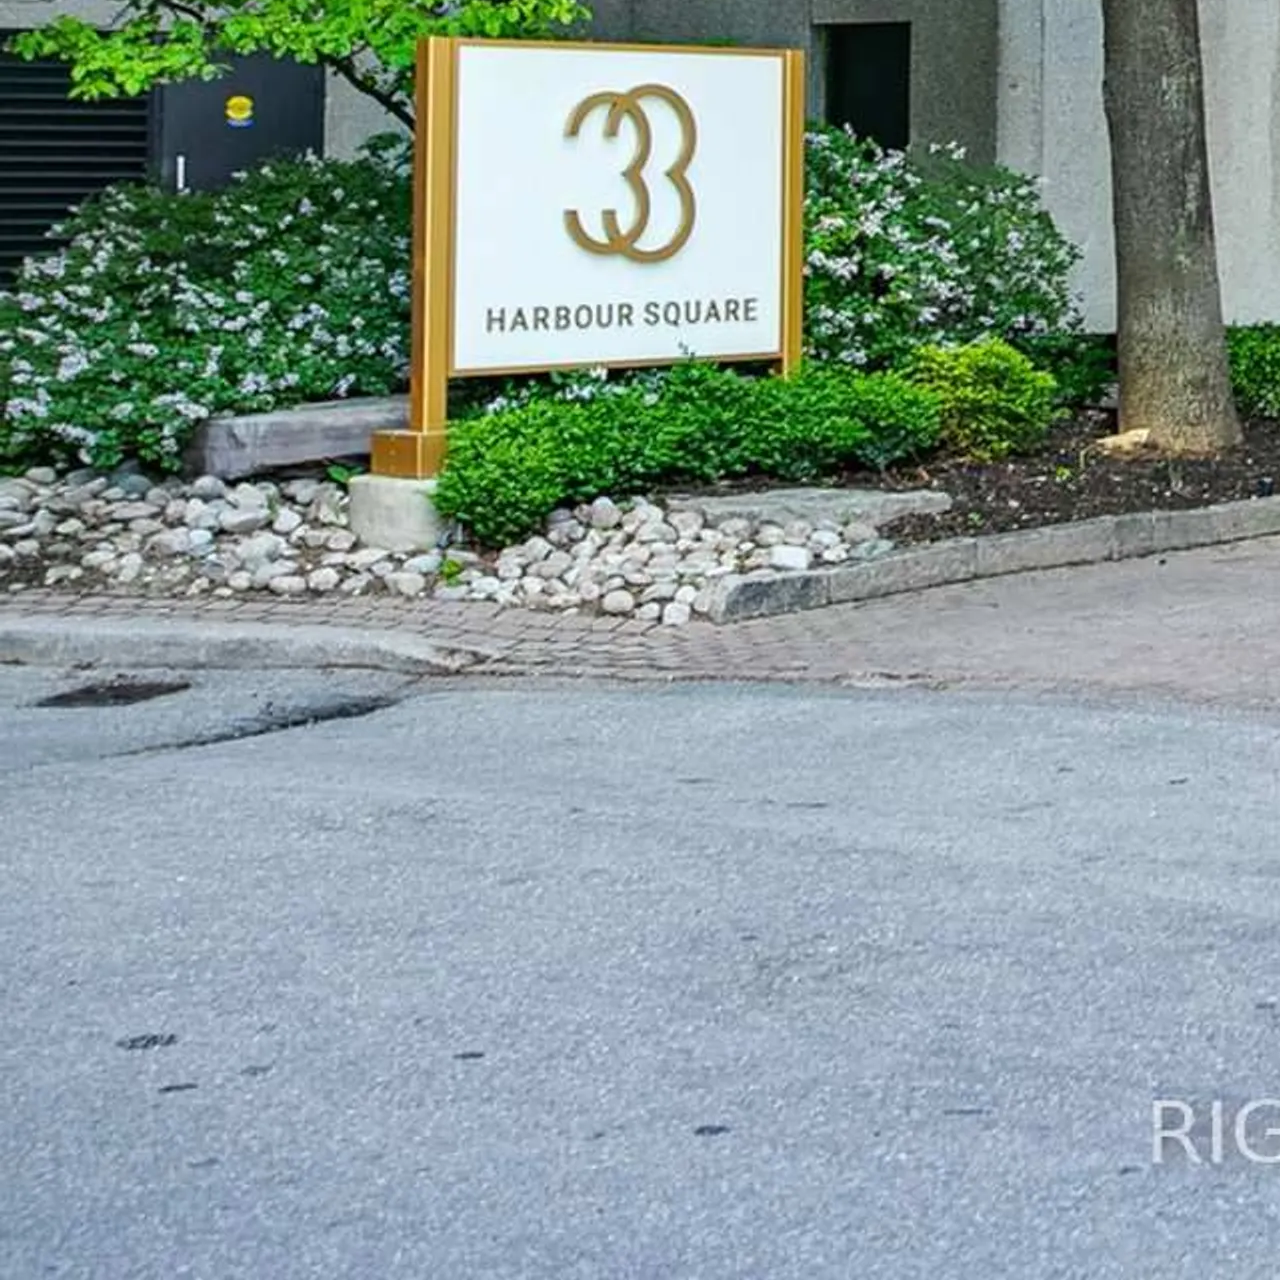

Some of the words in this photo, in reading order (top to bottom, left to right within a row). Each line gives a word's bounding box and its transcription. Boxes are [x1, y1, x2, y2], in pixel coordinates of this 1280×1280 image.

[563, 83, 698, 264] 33
[485, 302, 634, 333] HARBOUR
[643, 297, 759, 327] SQUARE
